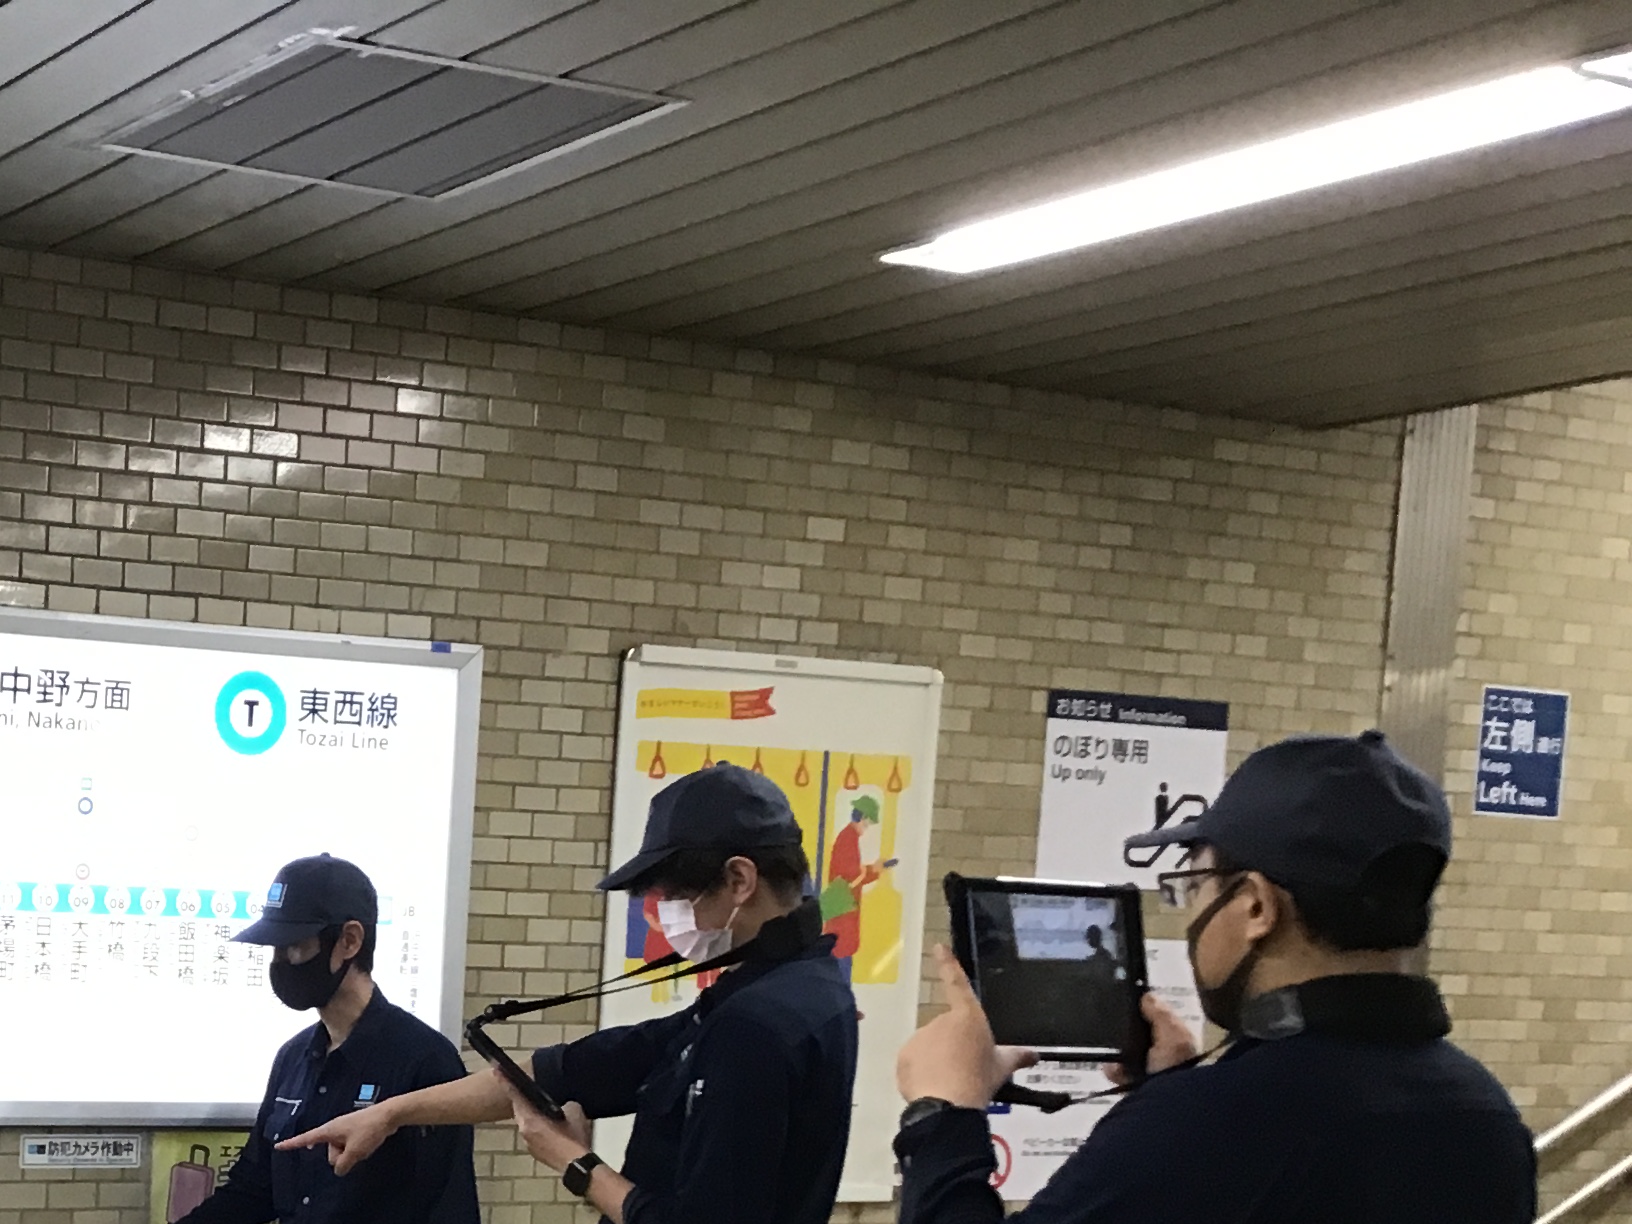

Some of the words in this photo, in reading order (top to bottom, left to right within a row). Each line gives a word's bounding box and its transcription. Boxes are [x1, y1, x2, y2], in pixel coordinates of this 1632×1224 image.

[0, 665, 132, 712] 中野方面
[244, 700, 259, 727] T
[298, 687, 399, 730] 東西線
[1056, 699, 1113, 719] お知らせ
[297, 728, 344, 749] Tozai
[351, 733, 389, 751] Line
[1053, 734, 1149, 764] のぼり専用
[1051, 764, 1071, 782] Up
[1075, 766, 1107, 784] only
[1479, 781, 1518, 804] Left
[38, 896, 52, 906] 10
[74, 897, 89, 908] 09
[110, 898, 125, 909] 08
[146, 899, 160, 911] 07
[181, 902, 196, 912] 06
[216, 903, 230, 914] 05
[34, 917, 52, 981] 日本橋
[70, 921, 89, 982] 大手町
[108, 921, 126, 962] 竹橋
[178, 922, 196, 986] 飯田橋
[212, 925, 230, 986] 神楽坂
[48, 1140, 134, 1158] 防犯カメラ作動中
